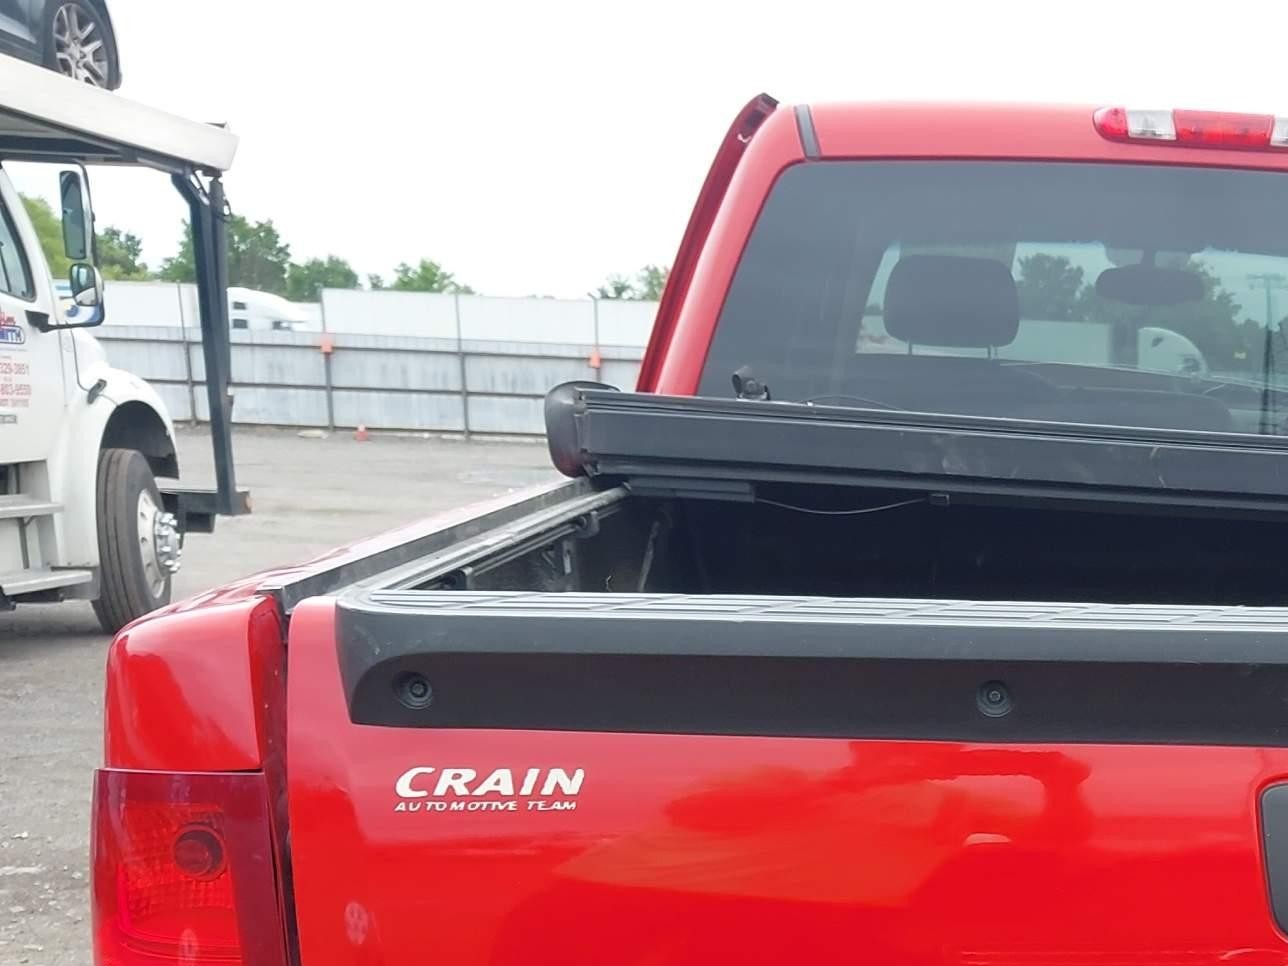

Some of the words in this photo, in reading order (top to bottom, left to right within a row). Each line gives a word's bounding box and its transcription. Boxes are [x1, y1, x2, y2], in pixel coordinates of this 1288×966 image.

[395, 767, 585, 797] CRAIN
[394, 801, 517, 812] AUTOMOTIVE
[527, 801, 577, 811] TEAM
